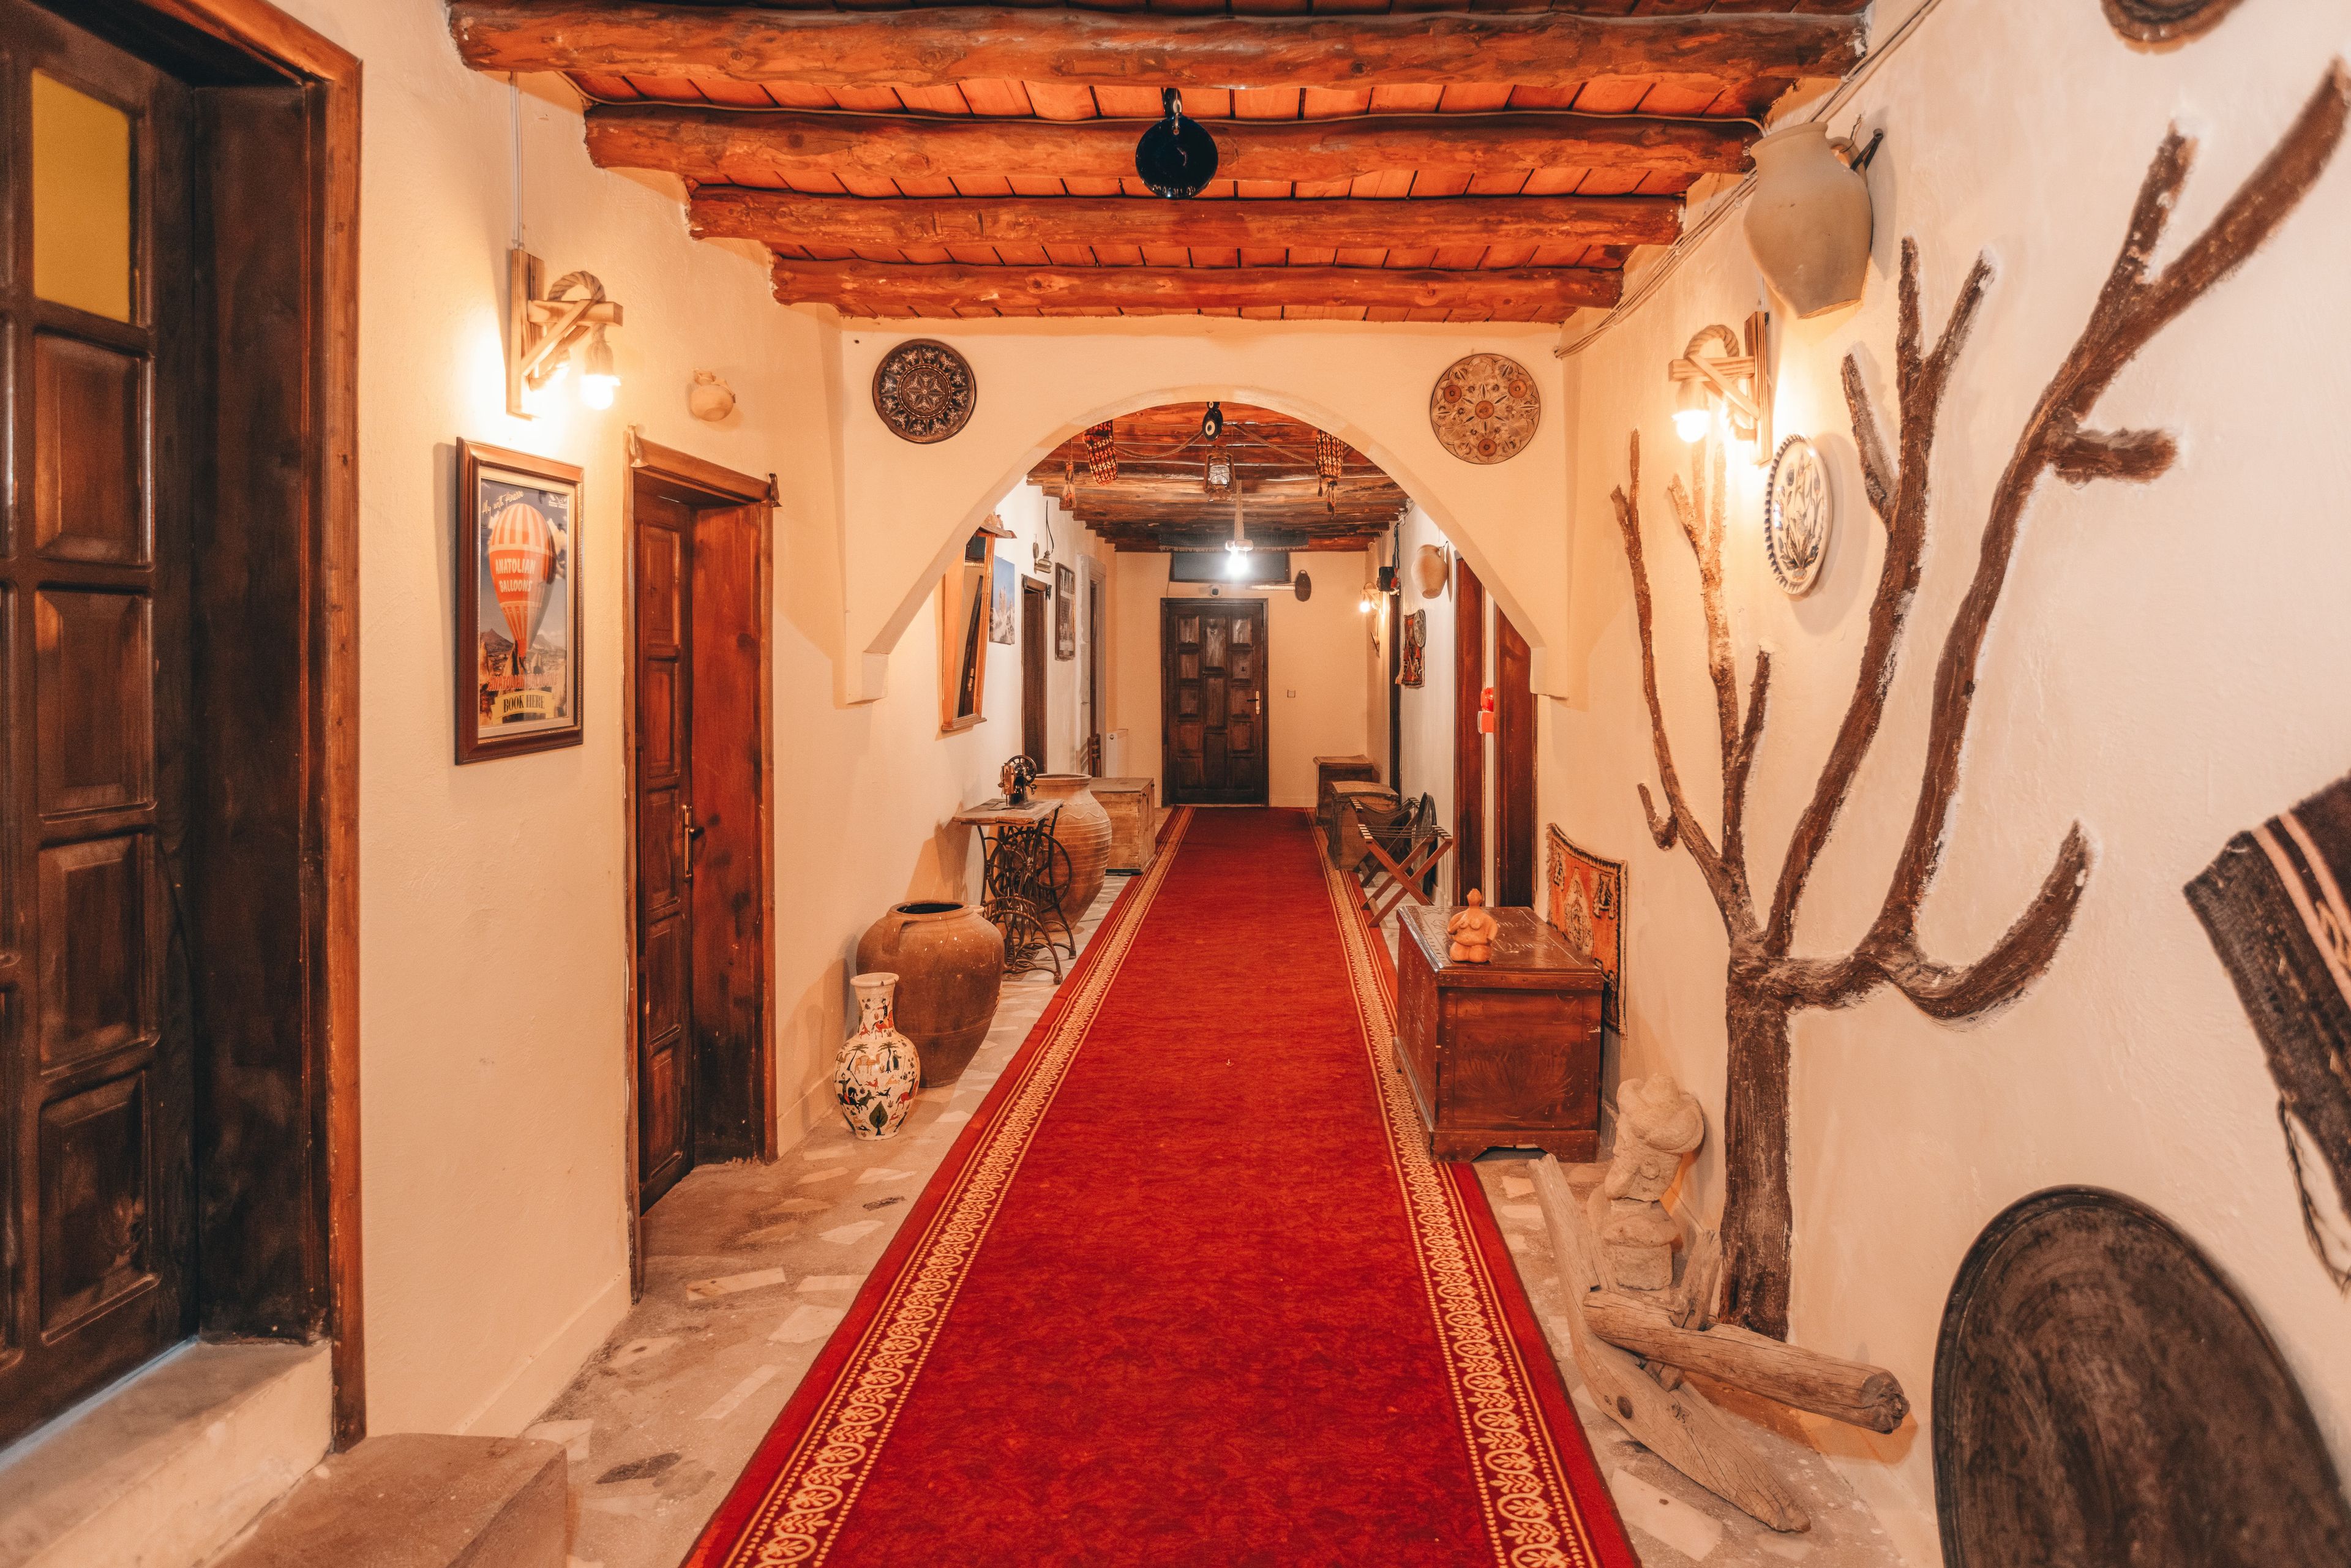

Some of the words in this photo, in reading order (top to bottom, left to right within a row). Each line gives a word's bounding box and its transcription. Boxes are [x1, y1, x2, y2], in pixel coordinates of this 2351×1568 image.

[495, 558, 536, 574] ANATOLIAN
[499, 579, 533, 593] BALLOONS
[503, 696, 524, 713] BOOK
[527, 694, 545, 709] HERE
